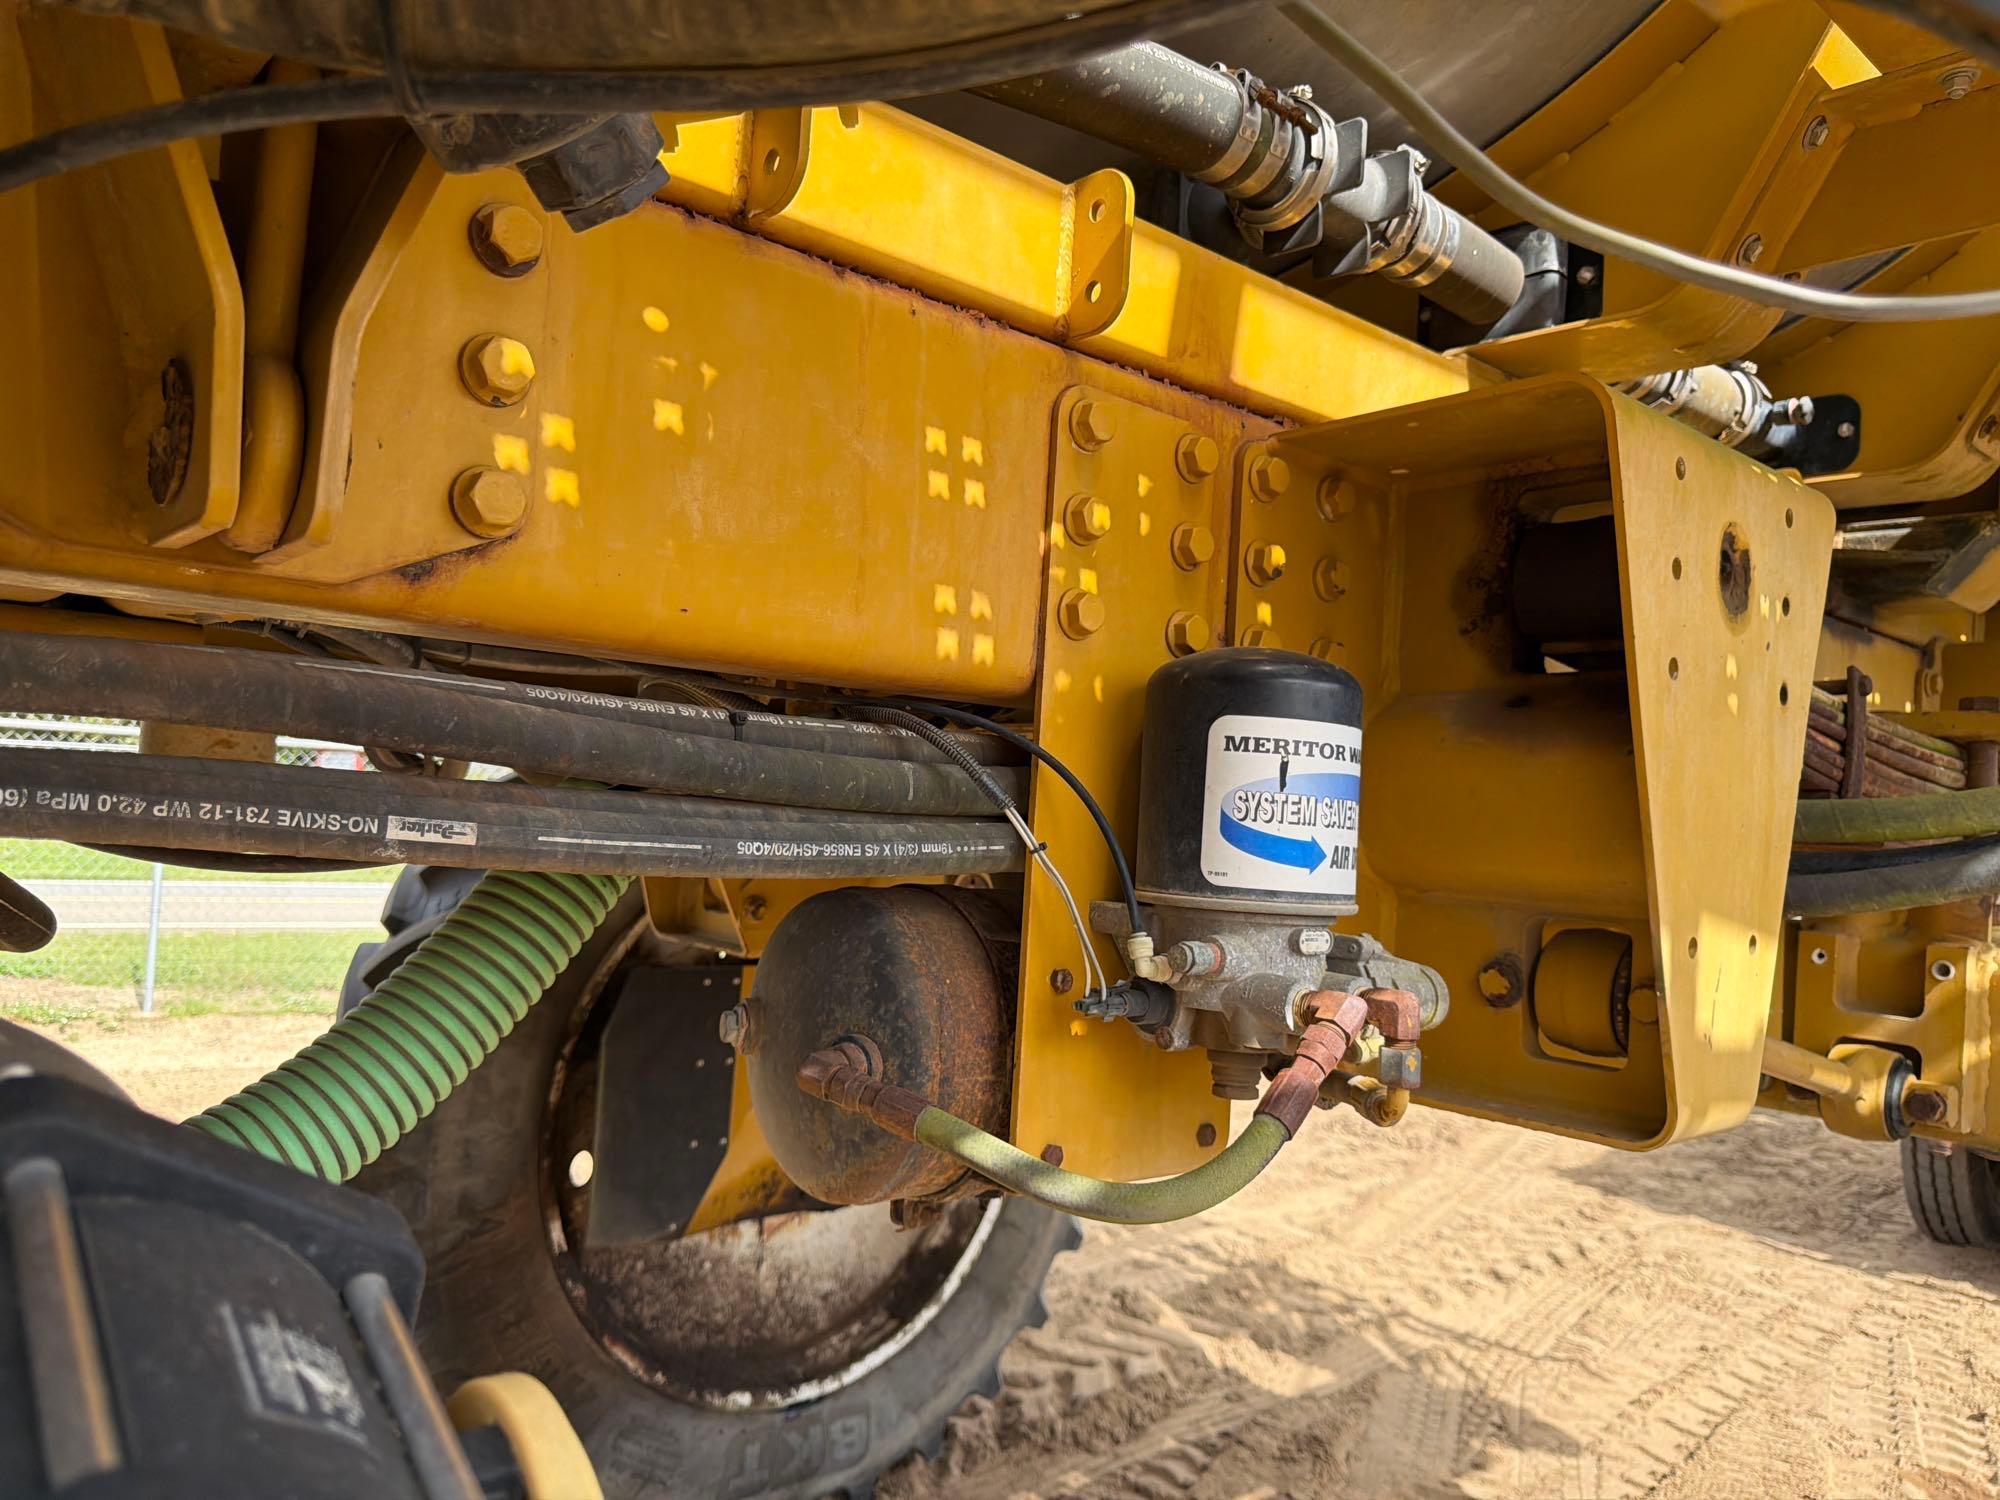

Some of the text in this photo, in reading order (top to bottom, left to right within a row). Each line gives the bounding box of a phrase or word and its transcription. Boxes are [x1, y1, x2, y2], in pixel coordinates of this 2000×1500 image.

[526, 687, 675, 715] EN856-4SH/20/4Q05
[681, 706, 696, 717] 4S
[701, 709, 710, 719] X
[747, 714, 783, 726] 19mm
[1223, 735, 1346, 761] MERITOR
[36, 790, 90, 811] MPa
[97, 793, 147, 815] 42,0
[153, 800, 192, 819] WP
[1232, 789, 1317, 827] SYSTEM
[199, 802, 270, 825] 731-12
[277, 809, 379, 834] NO-SKIVE
[399, 818, 466, 840] Parker
[736, 841, 953, 857] 19mm (3/4) X 4S EN856-4SH/20/4Q05
[1329, 845, 1350, 869] AIR
[730, 1413, 867, 1491] BKT
